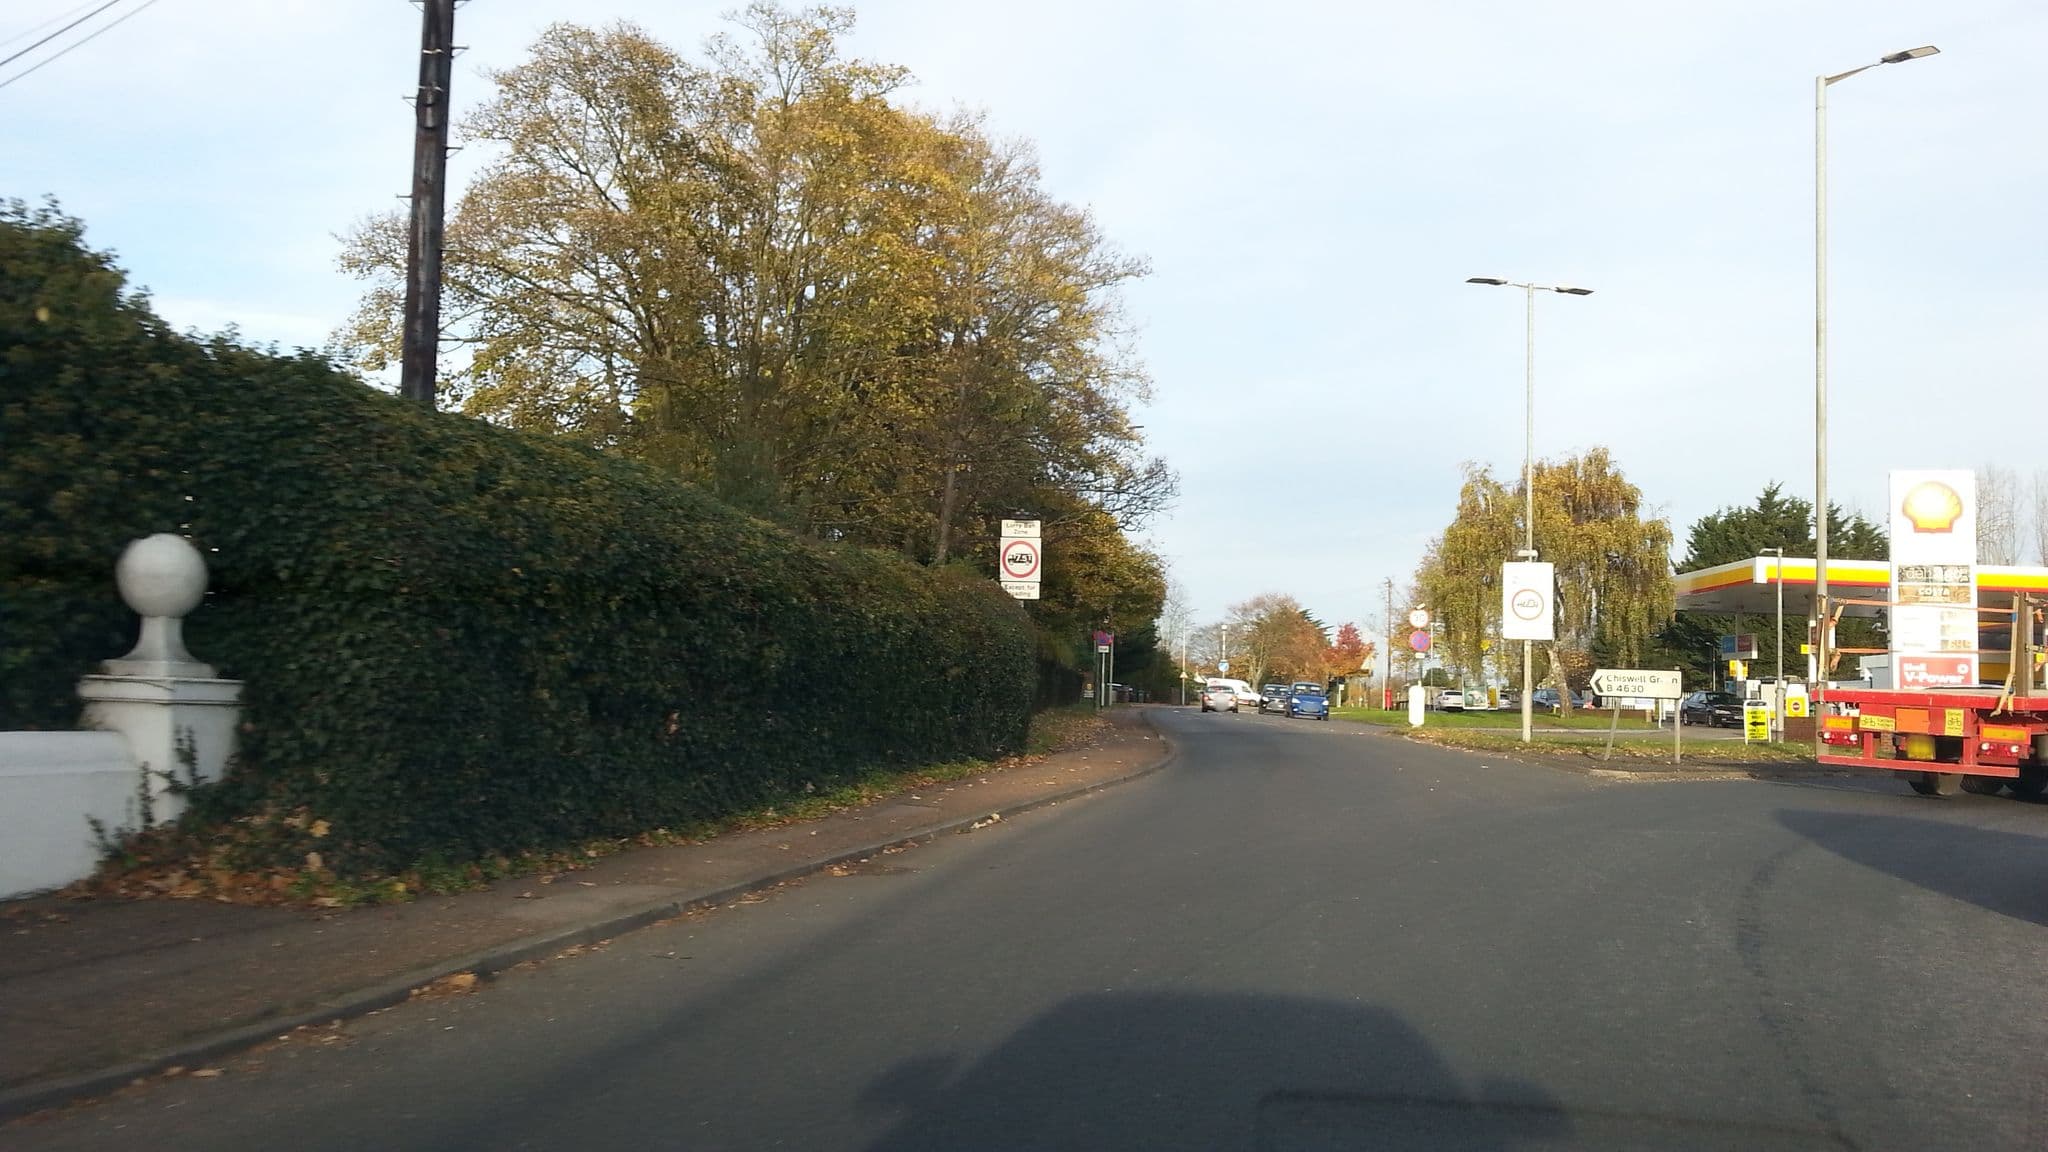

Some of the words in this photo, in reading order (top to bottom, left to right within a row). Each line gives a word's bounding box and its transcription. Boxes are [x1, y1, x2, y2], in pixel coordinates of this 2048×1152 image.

[1606, 674, 1647, 683] Chiswell
[1606, 684, 1613, 692] B
[1616, 684, 1645, 693] 4630
